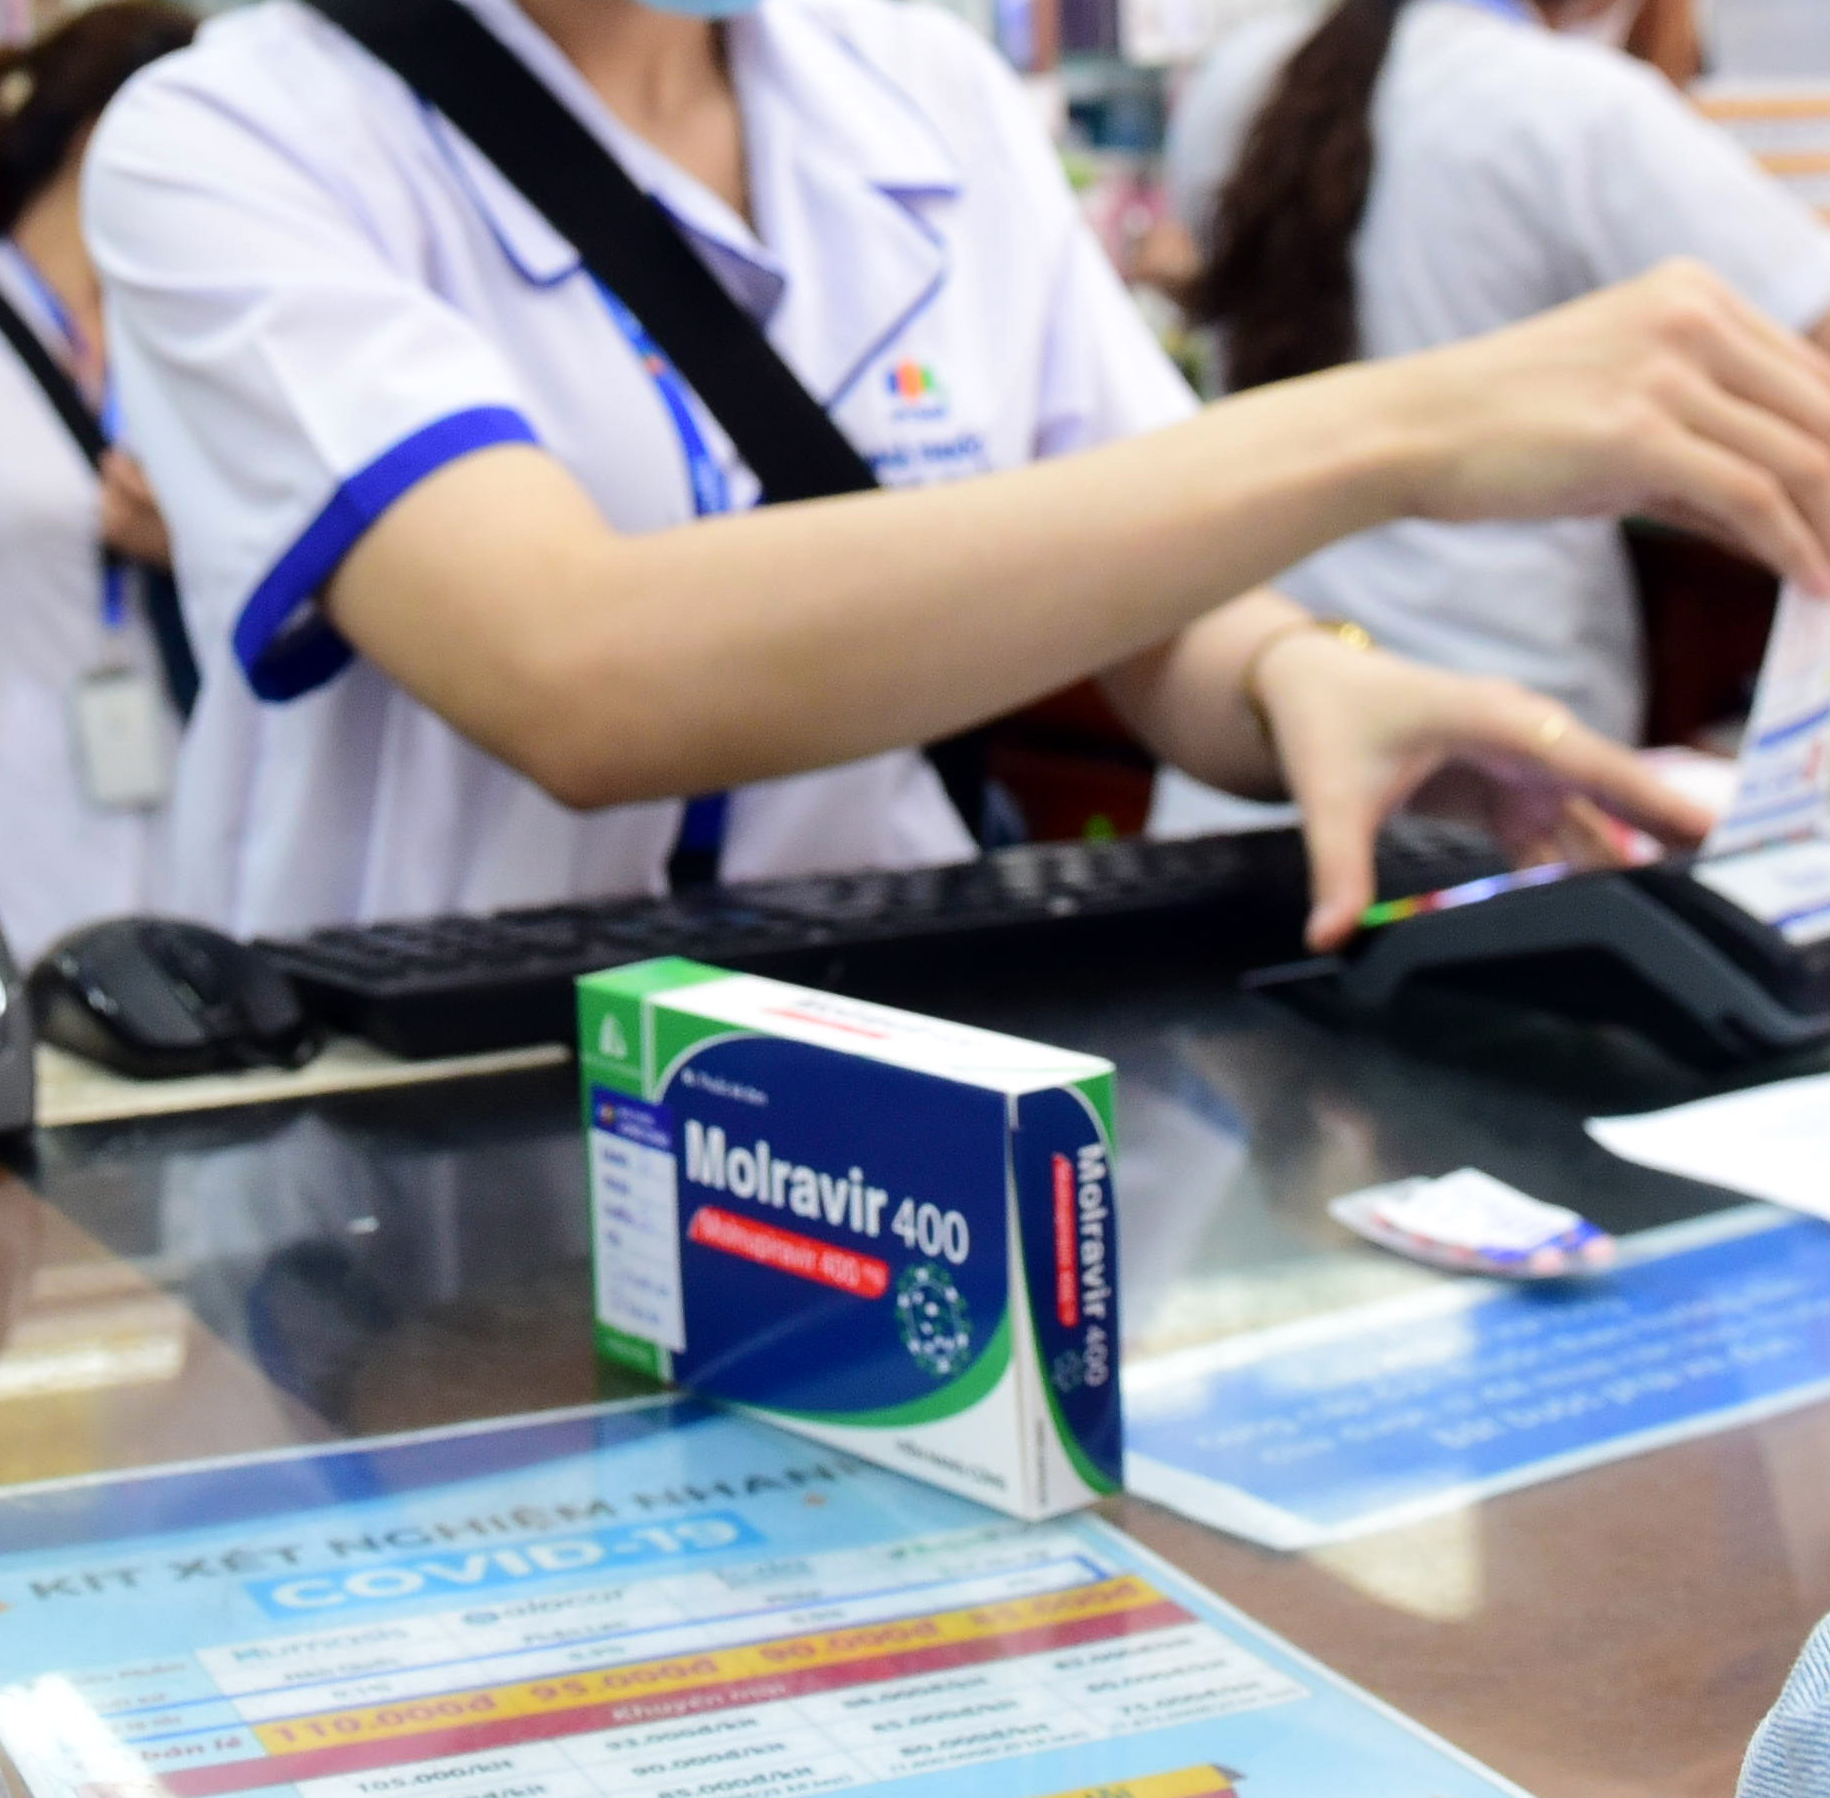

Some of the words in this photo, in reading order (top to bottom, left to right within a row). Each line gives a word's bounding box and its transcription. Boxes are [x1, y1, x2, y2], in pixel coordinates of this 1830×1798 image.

[684, 1119, 888, 1238] Molravir
[892, 1196, 970, 1265] 400
[1077, 1143, 1113, 1320] Molravir
[1083, 1324, 1111, 1388] 400
[273, 1519, 738, 1609] COVID-19
